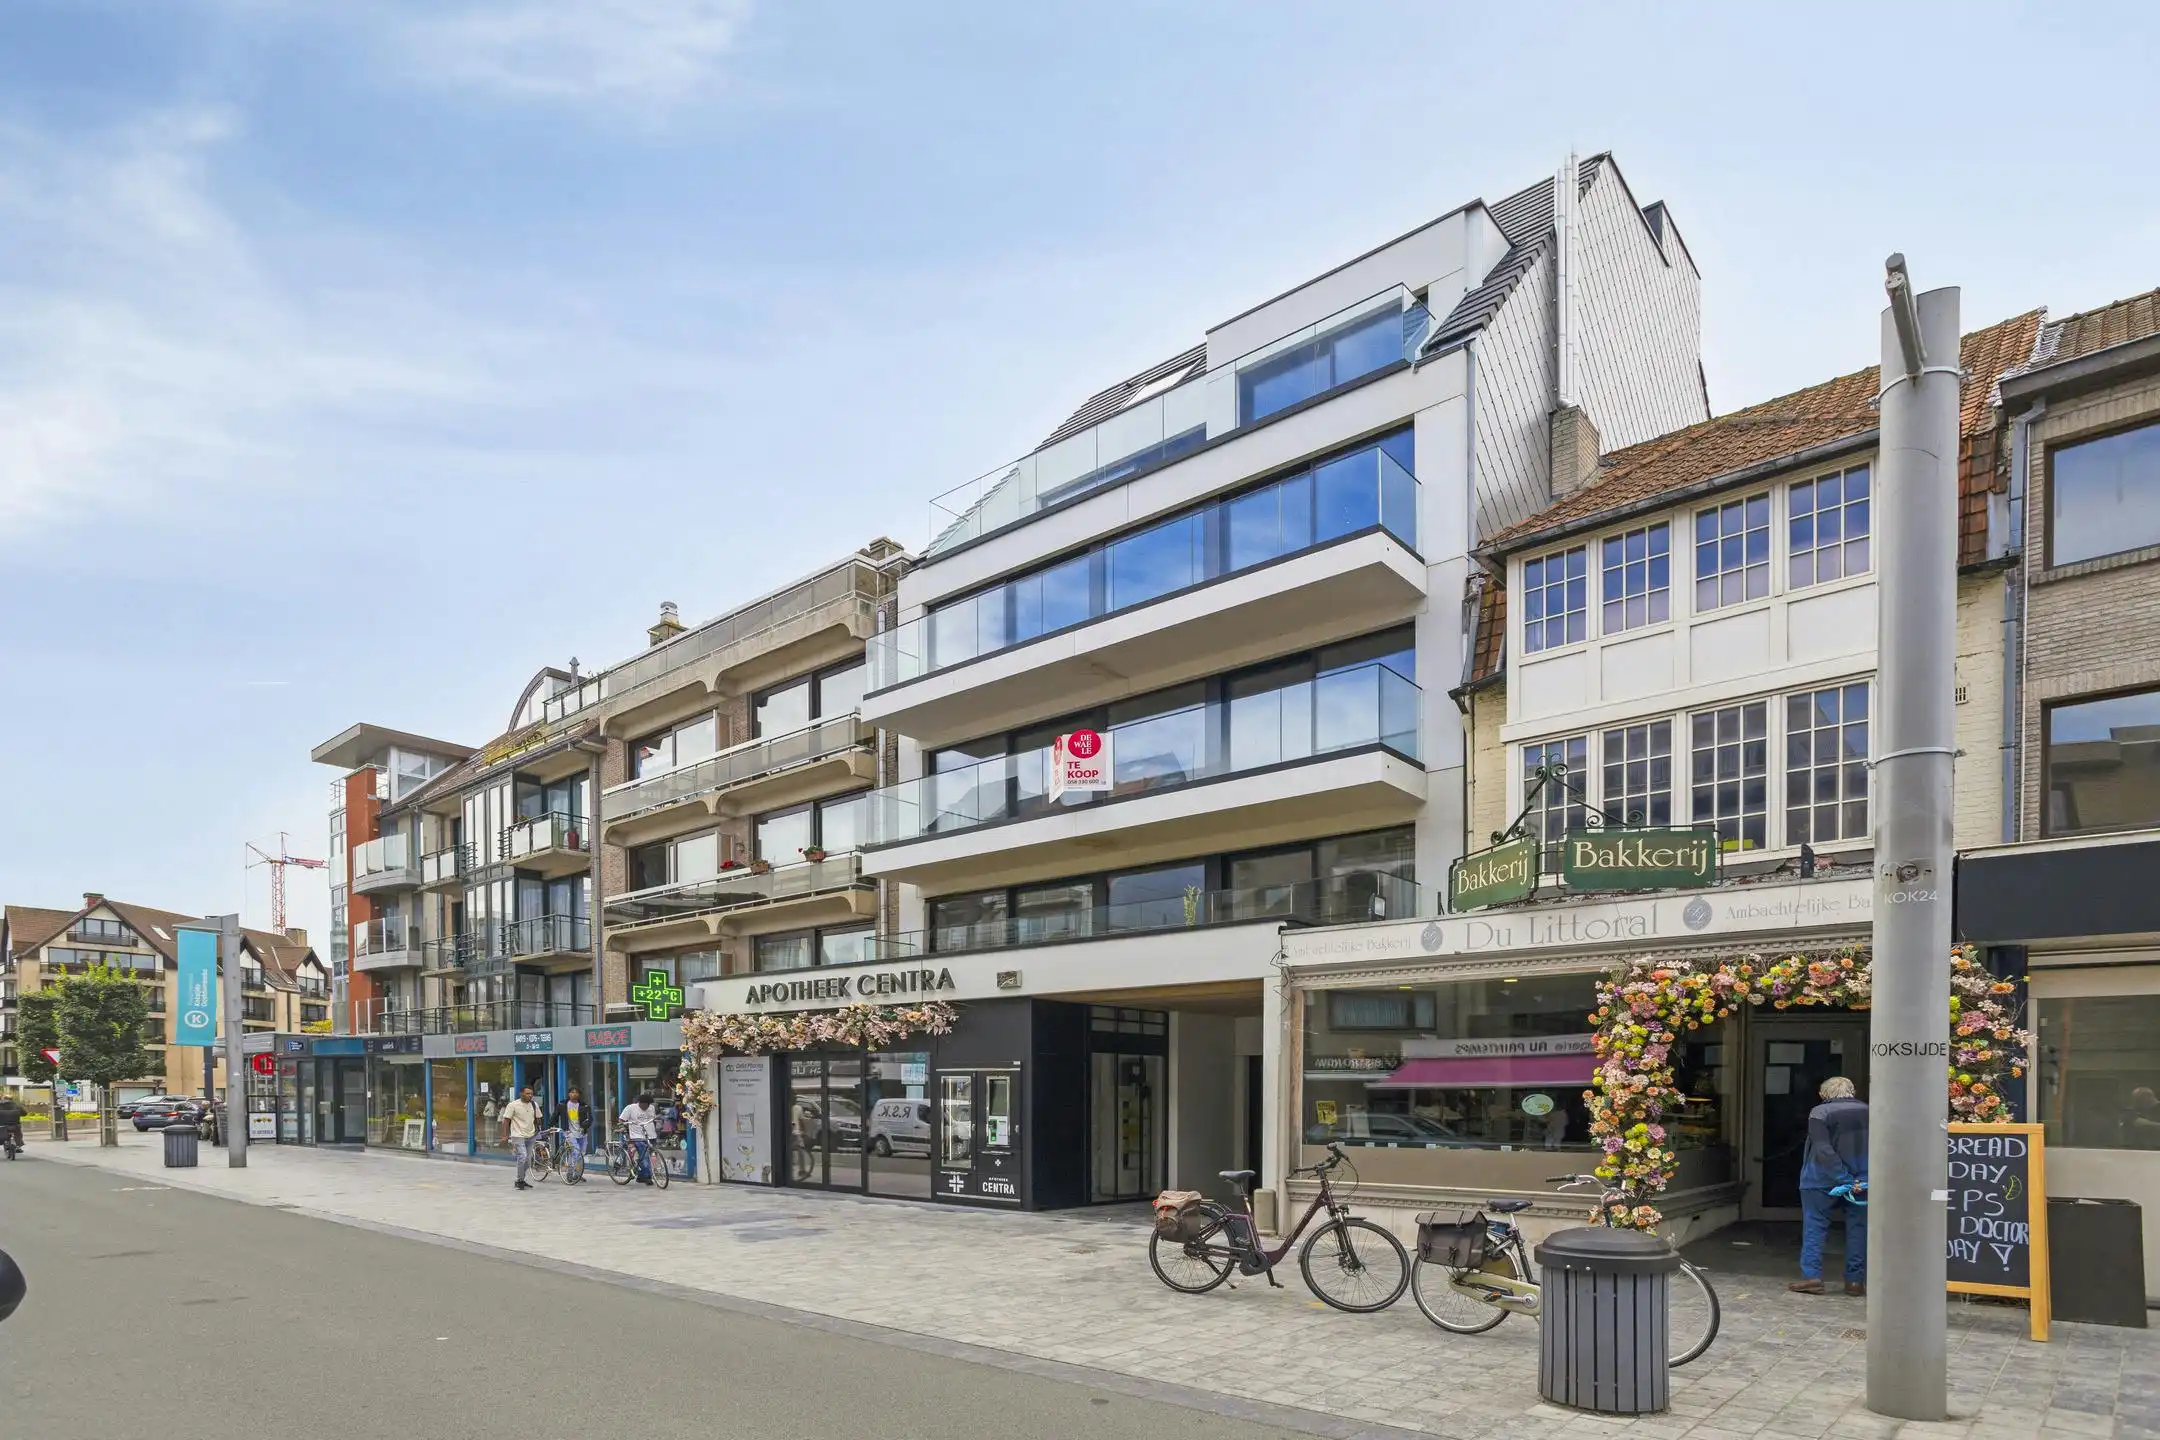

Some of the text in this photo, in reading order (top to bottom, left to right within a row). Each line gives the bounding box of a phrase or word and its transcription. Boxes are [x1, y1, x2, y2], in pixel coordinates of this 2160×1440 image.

[1081, 747, 1092, 755] LE
[1067, 761, 1081, 769] TE
[1067, 770, 1099, 779] KOOP
[1573, 838, 1708, 877] Bakkerij
[1457, 849, 1529, 895] Bakkerij
[1725, 892, 1841, 921] Ambachtelijke
[1884, 889, 1938, 905] KOK24
[1466, 920, 1511, 950] Du
[1529, 901, 1659, 946] Littoral
[745, 967, 956, 1005] APOTHEEK CENTRA
[1871, 1042, 1947, 1057] KOKSIJDE
[1947, 1136, 2027, 1158] BREAD
[1948, 1161, 2008, 1184] DAY
[982, 1181, 1015, 1195] CENTRA
[1960, 1216, 2029, 1246] DOCTOR
